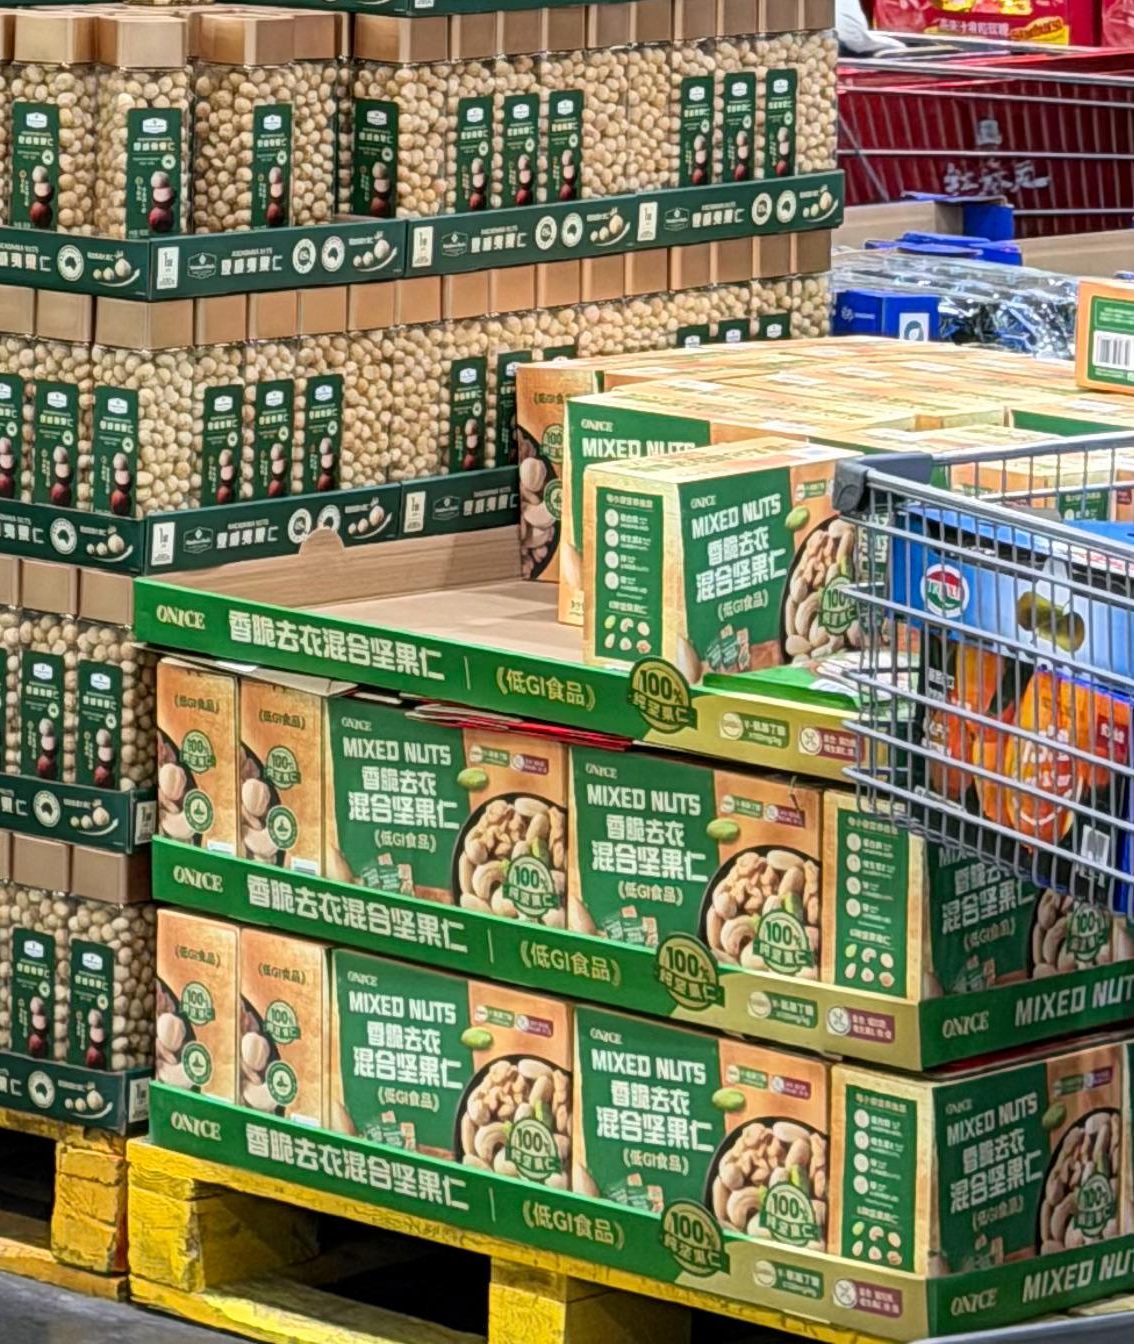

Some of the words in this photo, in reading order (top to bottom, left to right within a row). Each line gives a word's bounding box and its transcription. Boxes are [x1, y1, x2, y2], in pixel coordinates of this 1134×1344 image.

[582, 437, 640, 459] MIXED
[691, 506, 740, 540] MIXED
[742, 493, 782, 522] NUTS
[708, 528, 769, 565] 香脆去衣
[695, 549, 788, 604] 混合坚果仁
[156, 604, 206, 630] ONICE
[228, 609, 446, 681] 香脆去衣混合坚果仁
[342, 737, 400, 762] MIXED
[403, 741, 453, 766] NUTS
[362, 766, 437, 797] 香脆去衣
[587, 783, 646, 811] MIXED
[651, 787, 701, 815] NUTS
[348, 792, 460, 830] 混合坚果仁
[606, 814, 686, 845] 香脆去衣
[173, 864, 224, 894] ONICE
[591, 841, 709, 882] 混合坚果仁
[247, 874, 469, 953] 香脆去衣混合坚果仁
[348, 991, 403, 1016] MIXED
[408, 996, 457, 1025] NUTS
[1015, 992, 1088, 1029] MIXED
[367, 1022, 441, 1054] 香脆去衣
[352, 1049, 463, 1090] 混合坚果仁
[591, 1048, 651, 1078] MIXED
[656, 1057, 707, 1085] NUTS
[611, 1079, 690, 1116] 香脆去衣
[171, 1111, 222, 1140] ONICE
[596, 1106, 715, 1153] 混合坚果仁
[245, 1123, 470, 1211] 香脆去衣混合坚果仁
